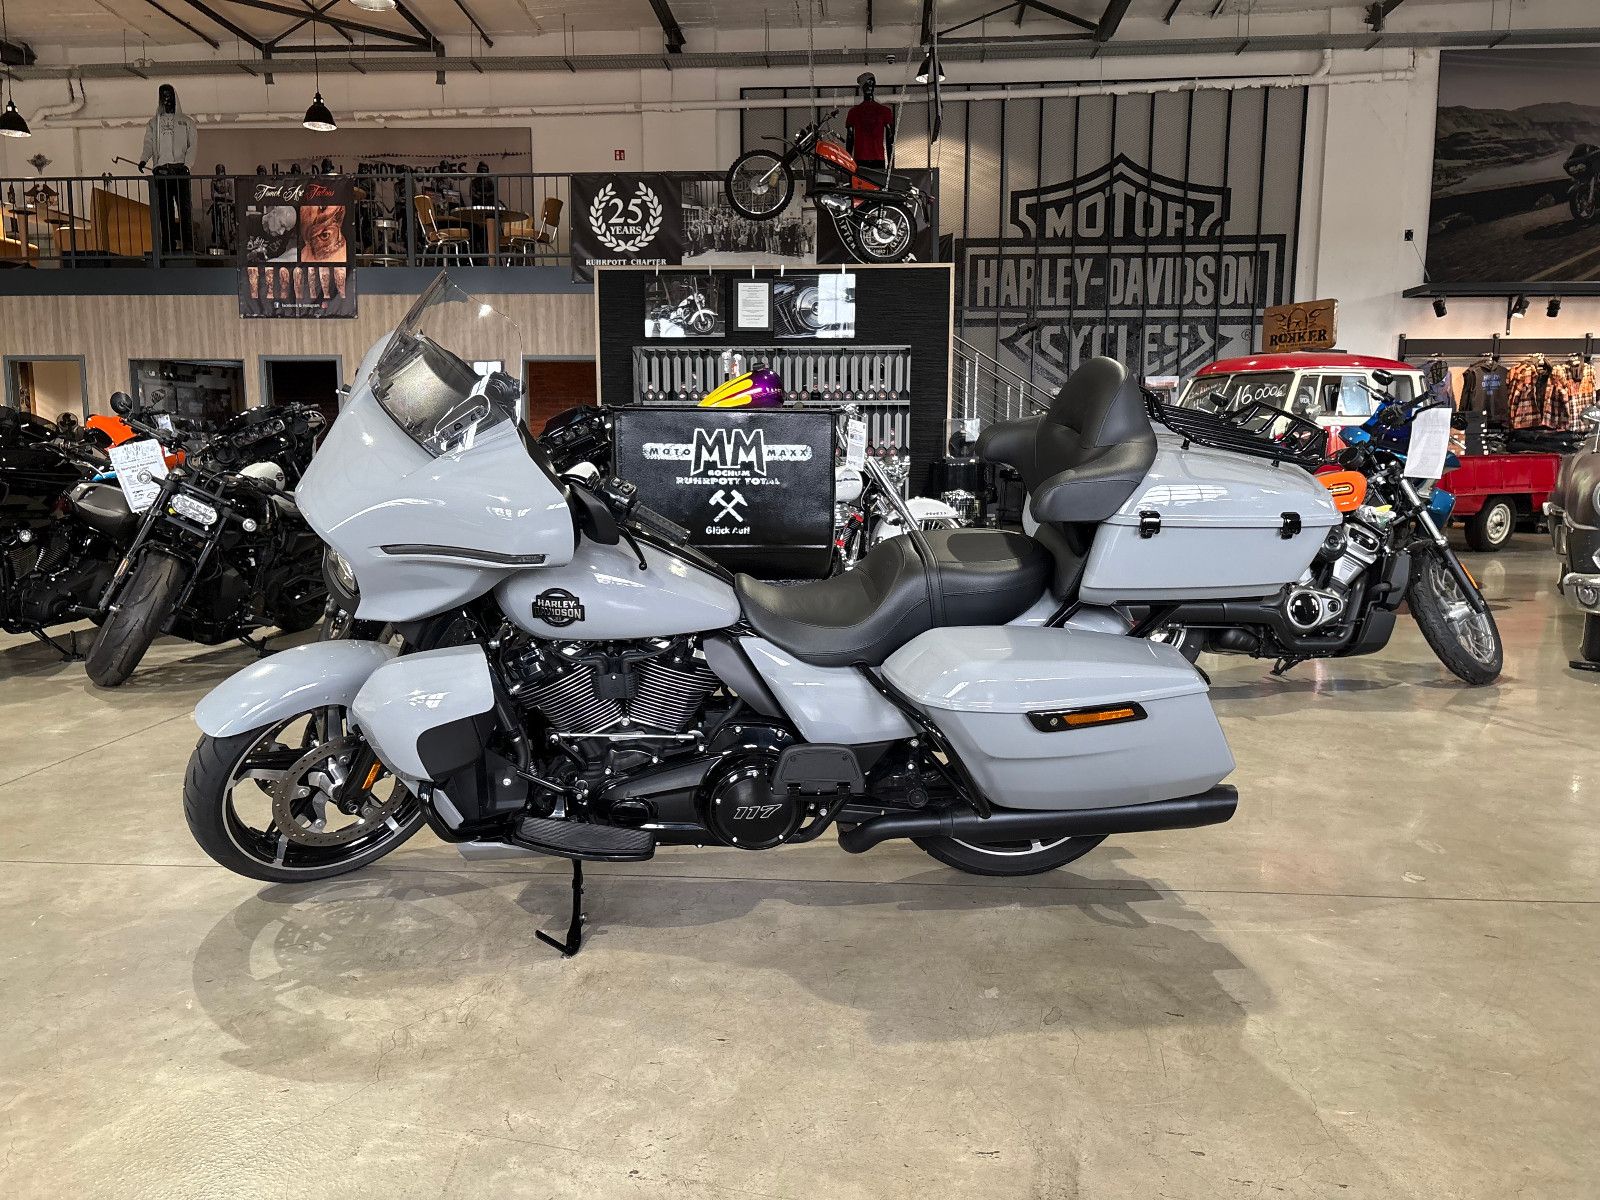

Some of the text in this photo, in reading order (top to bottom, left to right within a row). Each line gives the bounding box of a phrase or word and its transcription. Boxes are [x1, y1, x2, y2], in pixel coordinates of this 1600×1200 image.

[608, 198, 643, 224] 25
[1045, 179, 1195, 238] MOTOR
[610, 226, 642, 235] YEARS
[976, 255, 1255, 308] HARLEY-DAVIDSON
[1269, 328, 1328, 347] ROKKER
[650, 428, 808, 476] MOTO MM MAXX
[676, 477, 781, 485] RUHRPOTT TOTAL
[707, 469, 751, 477] BOCHUM
[705, 525, 730, 534] Glück
[534, 606, 582, 620] DAVIDSON
[733, 803, 783, 820] 117
